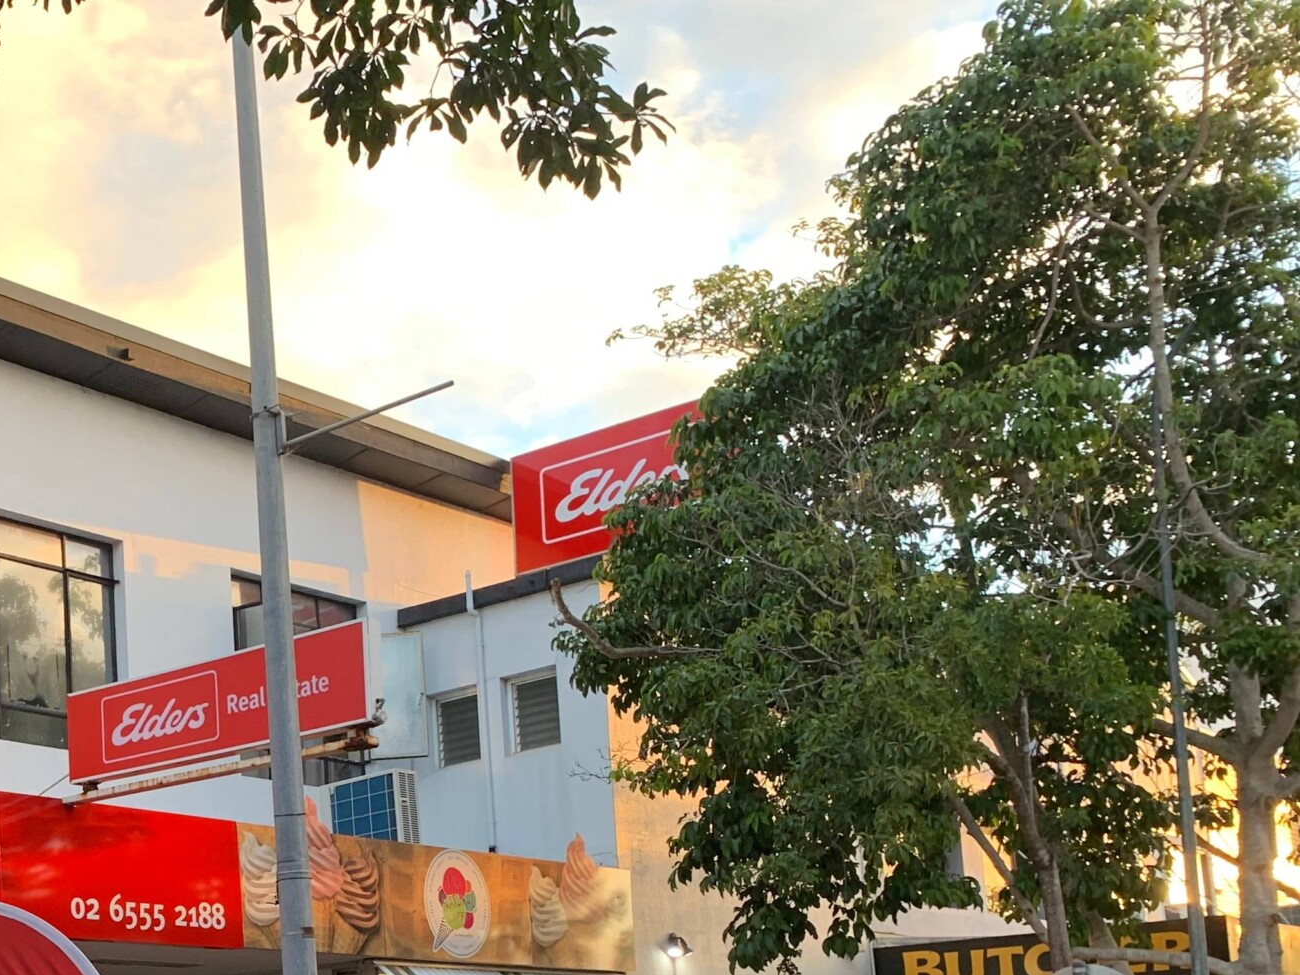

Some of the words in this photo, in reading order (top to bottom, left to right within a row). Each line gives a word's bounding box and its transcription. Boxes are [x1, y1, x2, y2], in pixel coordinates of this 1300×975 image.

[111, 697, 209, 747] Elders
[227, 686, 266, 715] Real
[296, 675, 330, 699] tate
[71, 896, 100, 922] 02
[109, 895, 167, 932] 6555
[174, 902, 226, 931] 2188
